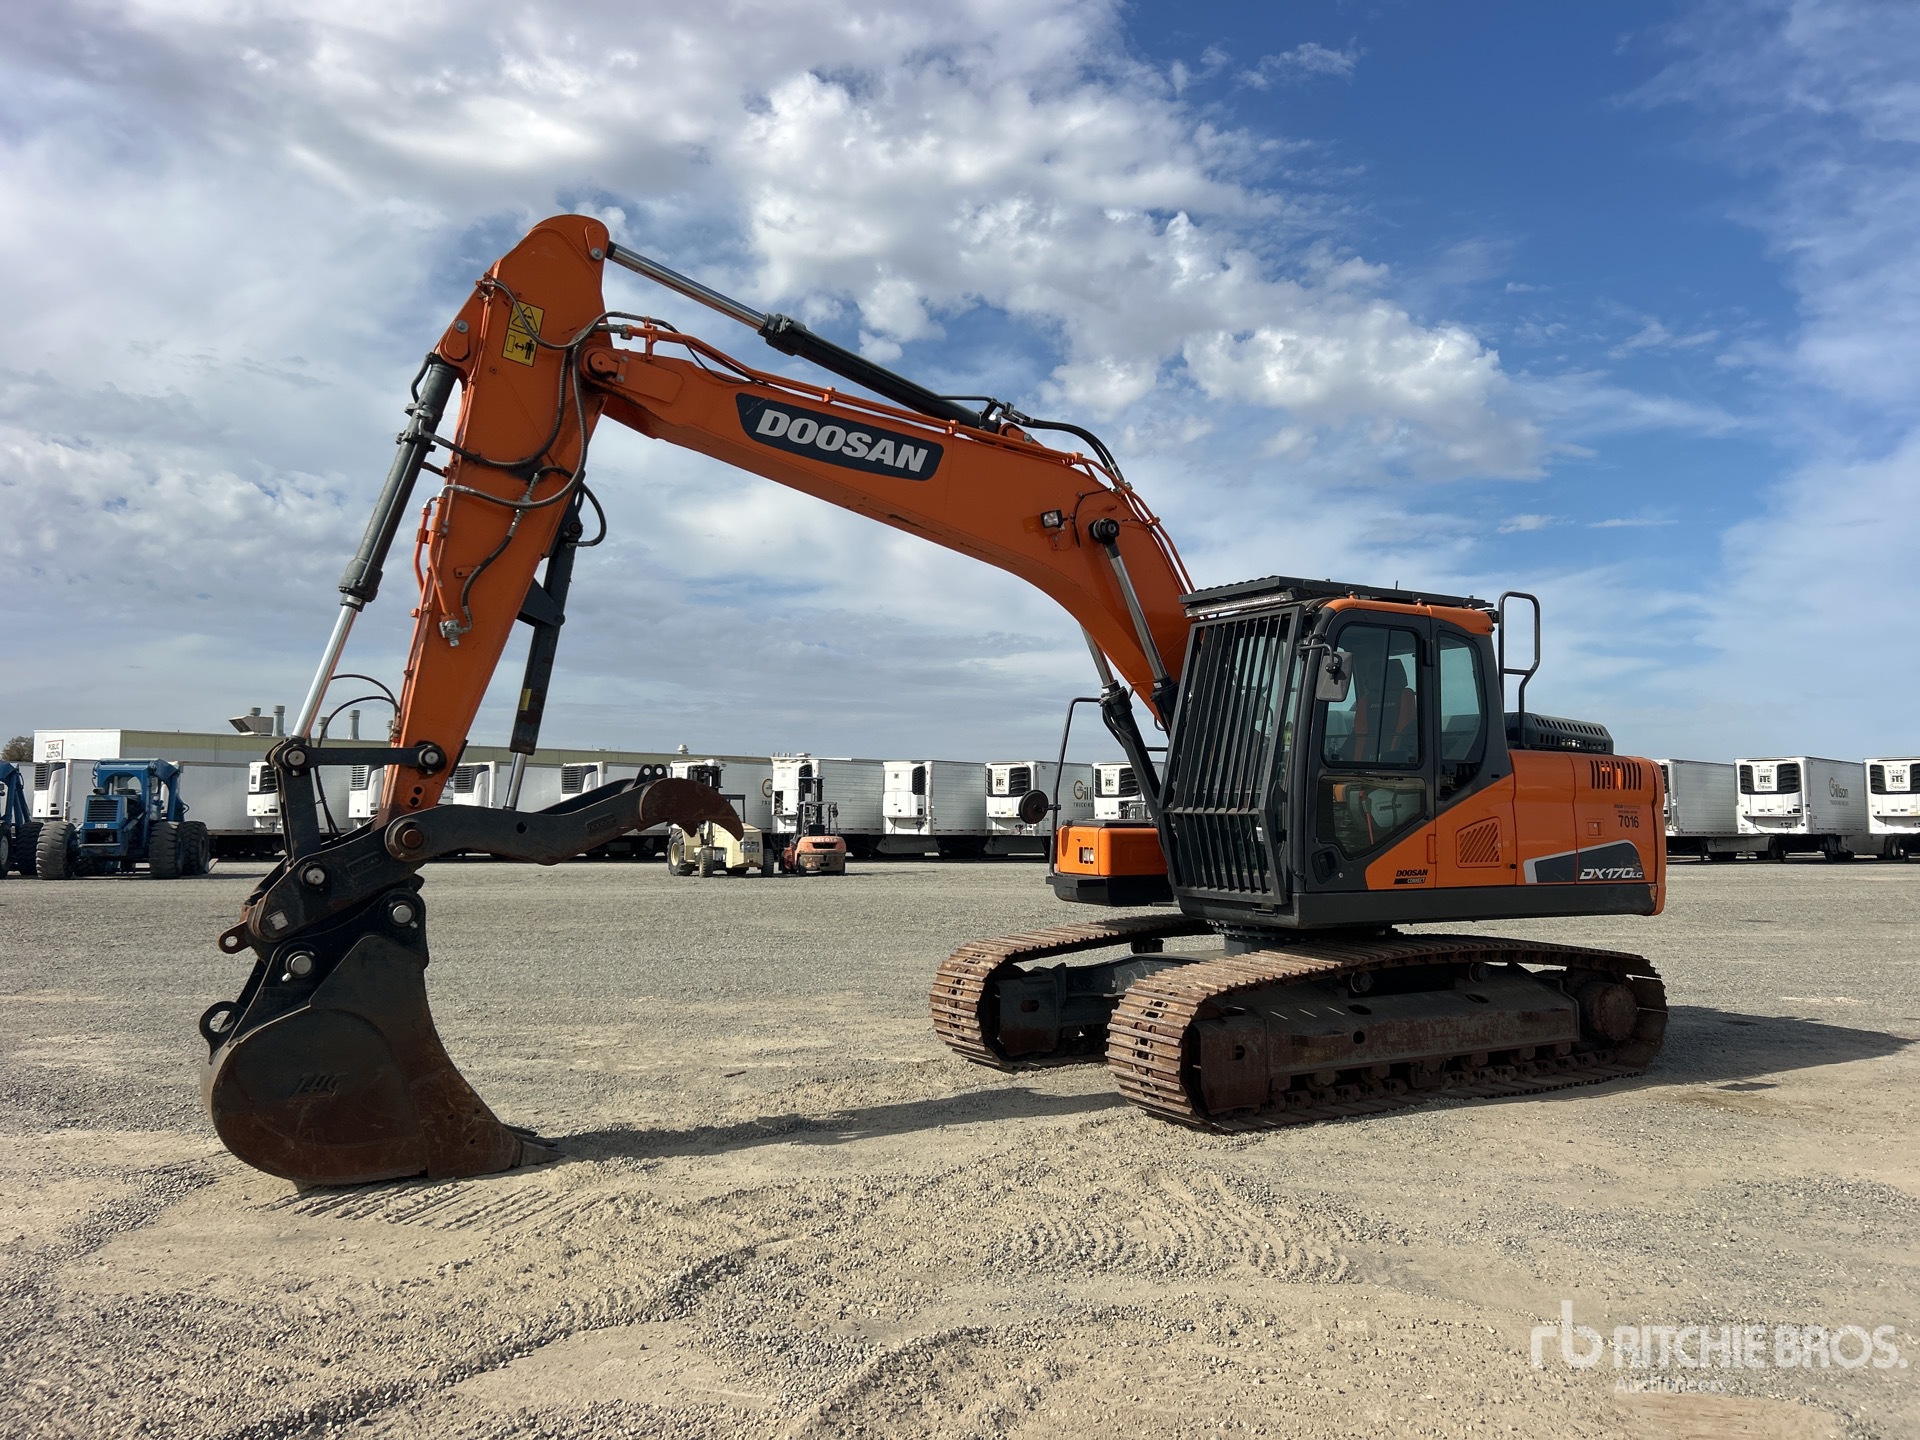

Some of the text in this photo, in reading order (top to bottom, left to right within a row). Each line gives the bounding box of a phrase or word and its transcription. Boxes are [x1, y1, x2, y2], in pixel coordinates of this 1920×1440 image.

[755, 408, 929, 473] DOOSAN
[1618, 814, 1640, 829] 7016
[1396, 868, 1429, 877] DOOSAN
